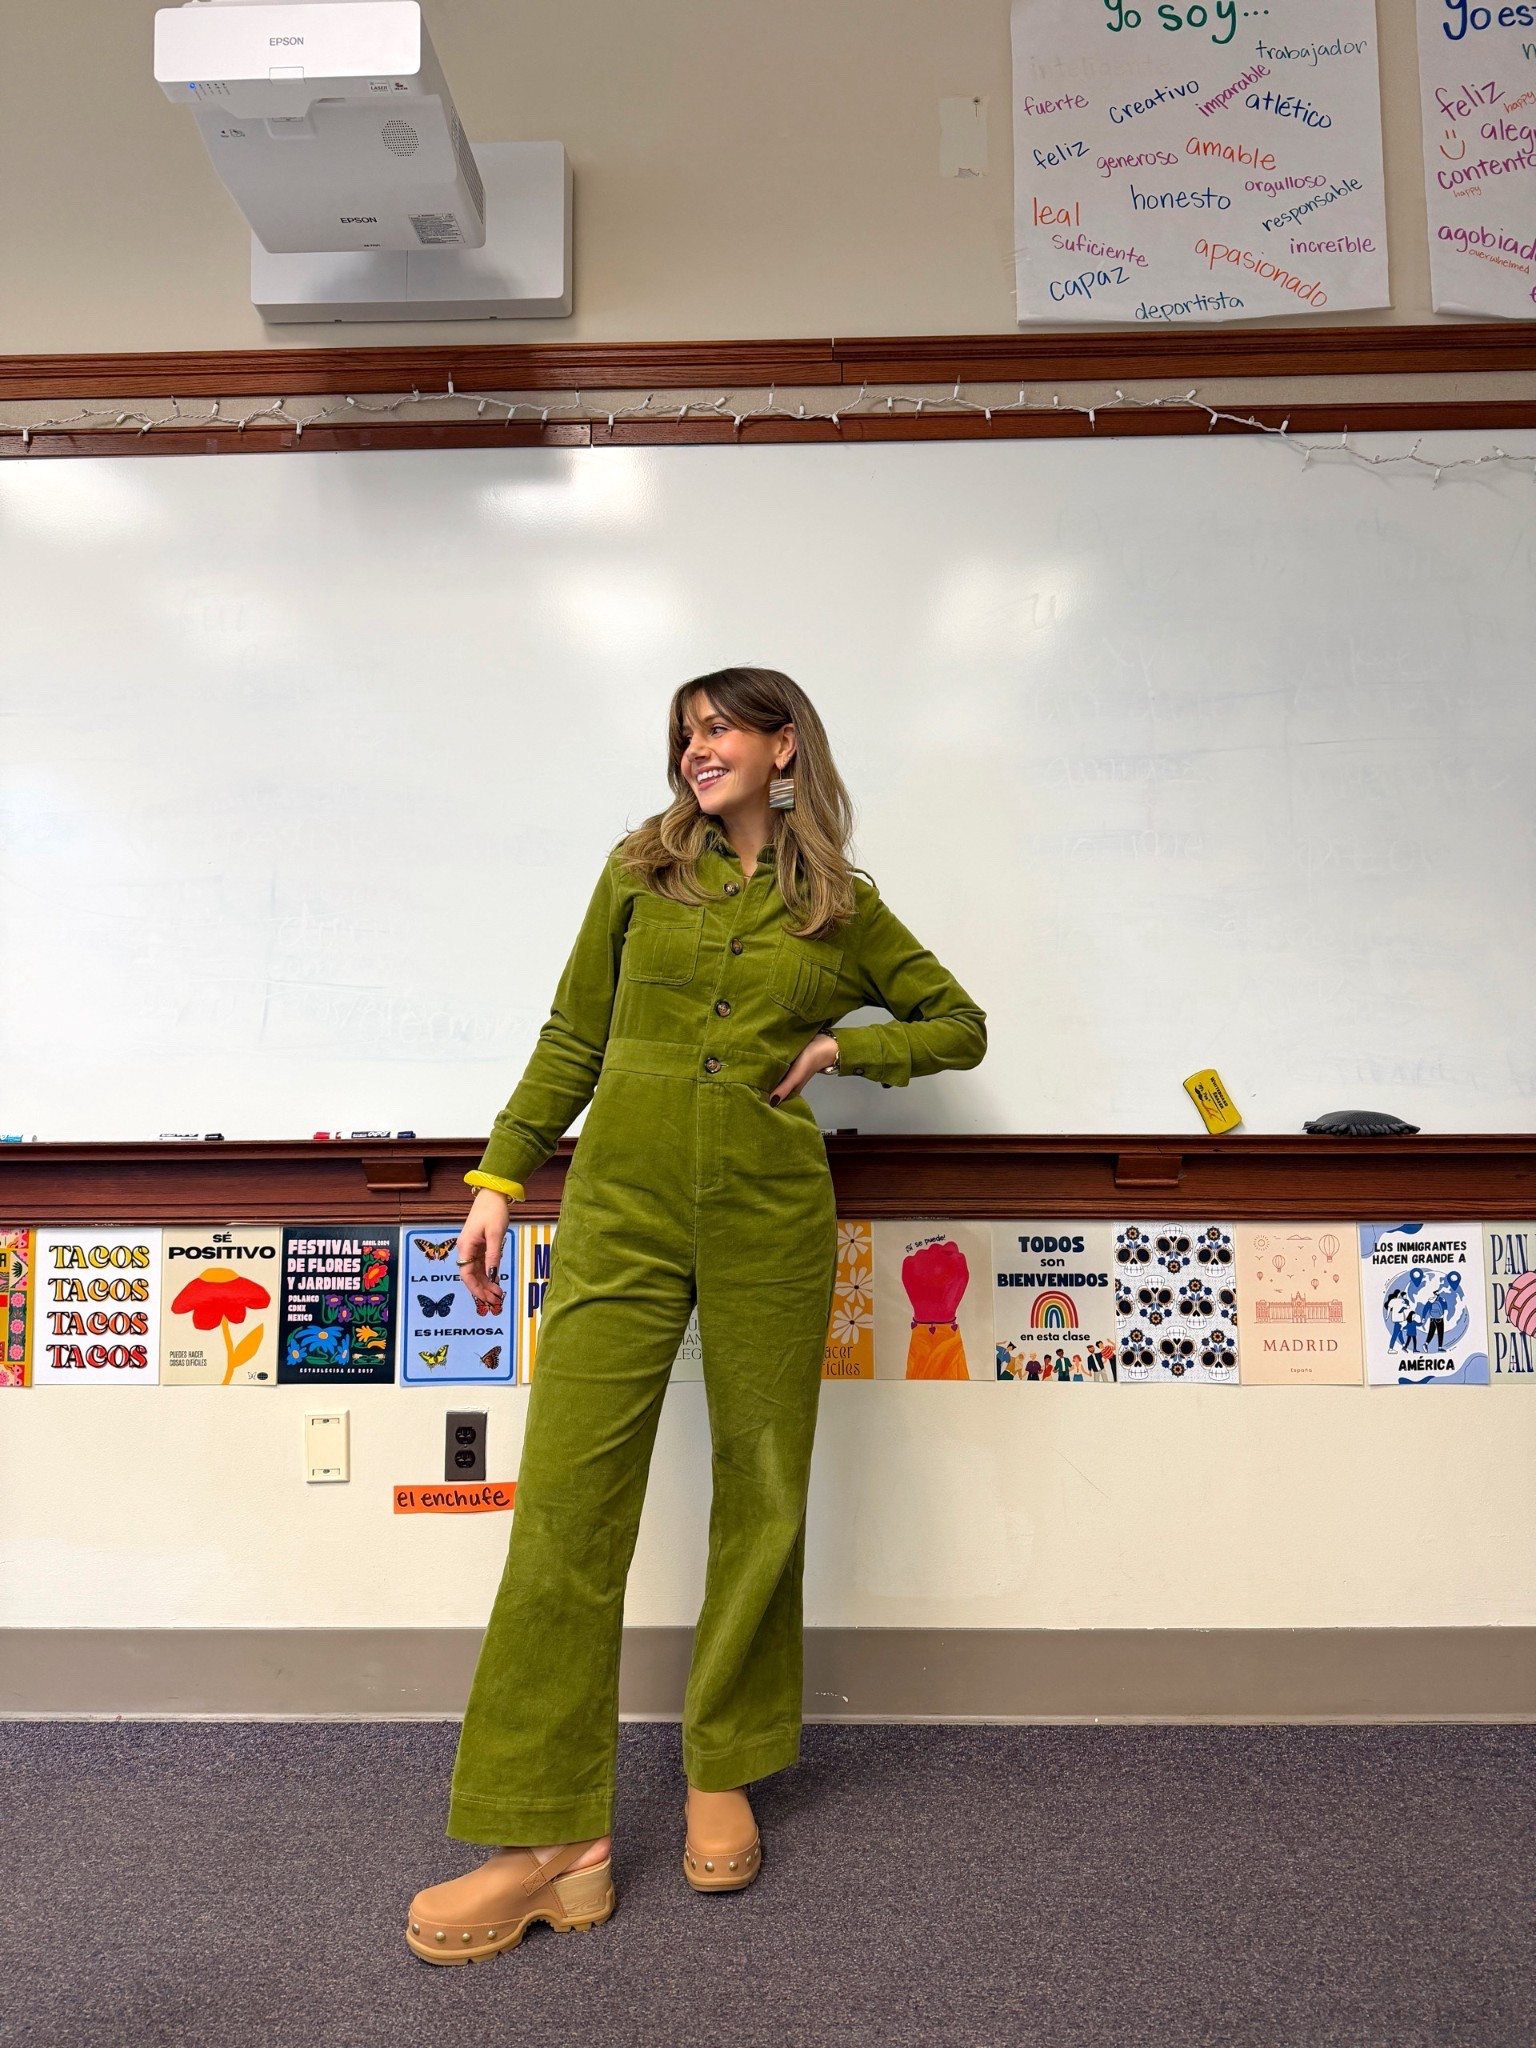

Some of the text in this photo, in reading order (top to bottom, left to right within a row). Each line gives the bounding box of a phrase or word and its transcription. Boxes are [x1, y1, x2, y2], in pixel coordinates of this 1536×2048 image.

[269, 37, 304, 46] EPSON
[1256, 38, 1367, 67] trabajador
[1196, 63, 1271, 117] imparable
[1435, 81, 1506, 121] feliz
[1503, 90, 1536, 114] happy
[1024, 93, 1089, 117] fuerte
[1245, 93, 1332, 129] atlético
[1480, 118, 1536, 154] aleg
[1033, 140, 1090, 170] feliz
[1096, 151, 1178, 178] generoso
[1186, 137, 1277, 171] amable
[1130, 184, 1231, 210] honesto
[1244, 174, 1327, 198] orgulloso
[1453, 185, 1482, 199] happy
[1033, 197, 1081, 226] leal
[1262, 176, 1363, 232] responsable
[1290, 236, 1376, 254] increíble
[1437, 225, 1536, 261] agobiad
[1194, 238, 1328, 307] apasionado
[1468, 248, 1530, 274] overwhelmed
[1135, 291, 1244, 322] deportista
[212, 1231, 232, 1243] SÉ
[287, 1239, 362, 1255] FESTIVAL
[1018, 1236, 1085, 1253] TODOS
[1374, 1241, 1467, 1253] LOS INMIGRANTES
[49, 1245, 150, 1269] TACOS
[168, 1246, 276, 1259] POSITIVO
[1040, 1257, 1065, 1267] son
[1372, 1253, 1466, 1265] HACEN GRANDE A
[1490, 1234, 1529, 1275] PAN
[287, 1258, 361, 1273] DE FLORES
[48, 1278, 149, 1302] TACOS
[287, 1276, 361, 1290] Y JARDINES
[997, 1273, 1109, 1287] BIENVENIDOS
[288, 1294, 319, 1303] POLANCO
[47, 1311, 149, 1336] TACOS
[287, 1313, 313, 1322] MEXICO
[414, 1327, 504, 1337] ES HERMOSA
[1020, 1331, 1091, 1341] en esta clase
[45, 1344, 148, 1369] TACOS
[825, 1346, 854, 1359] acer
[1263, 1339, 1339, 1352] MADRID
[1493, 1332, 1534, 1373] PAN
[1398, 1356, 1455, 1372] AMÉRICA
[397, 1486, 510, 1507] el enchufe
